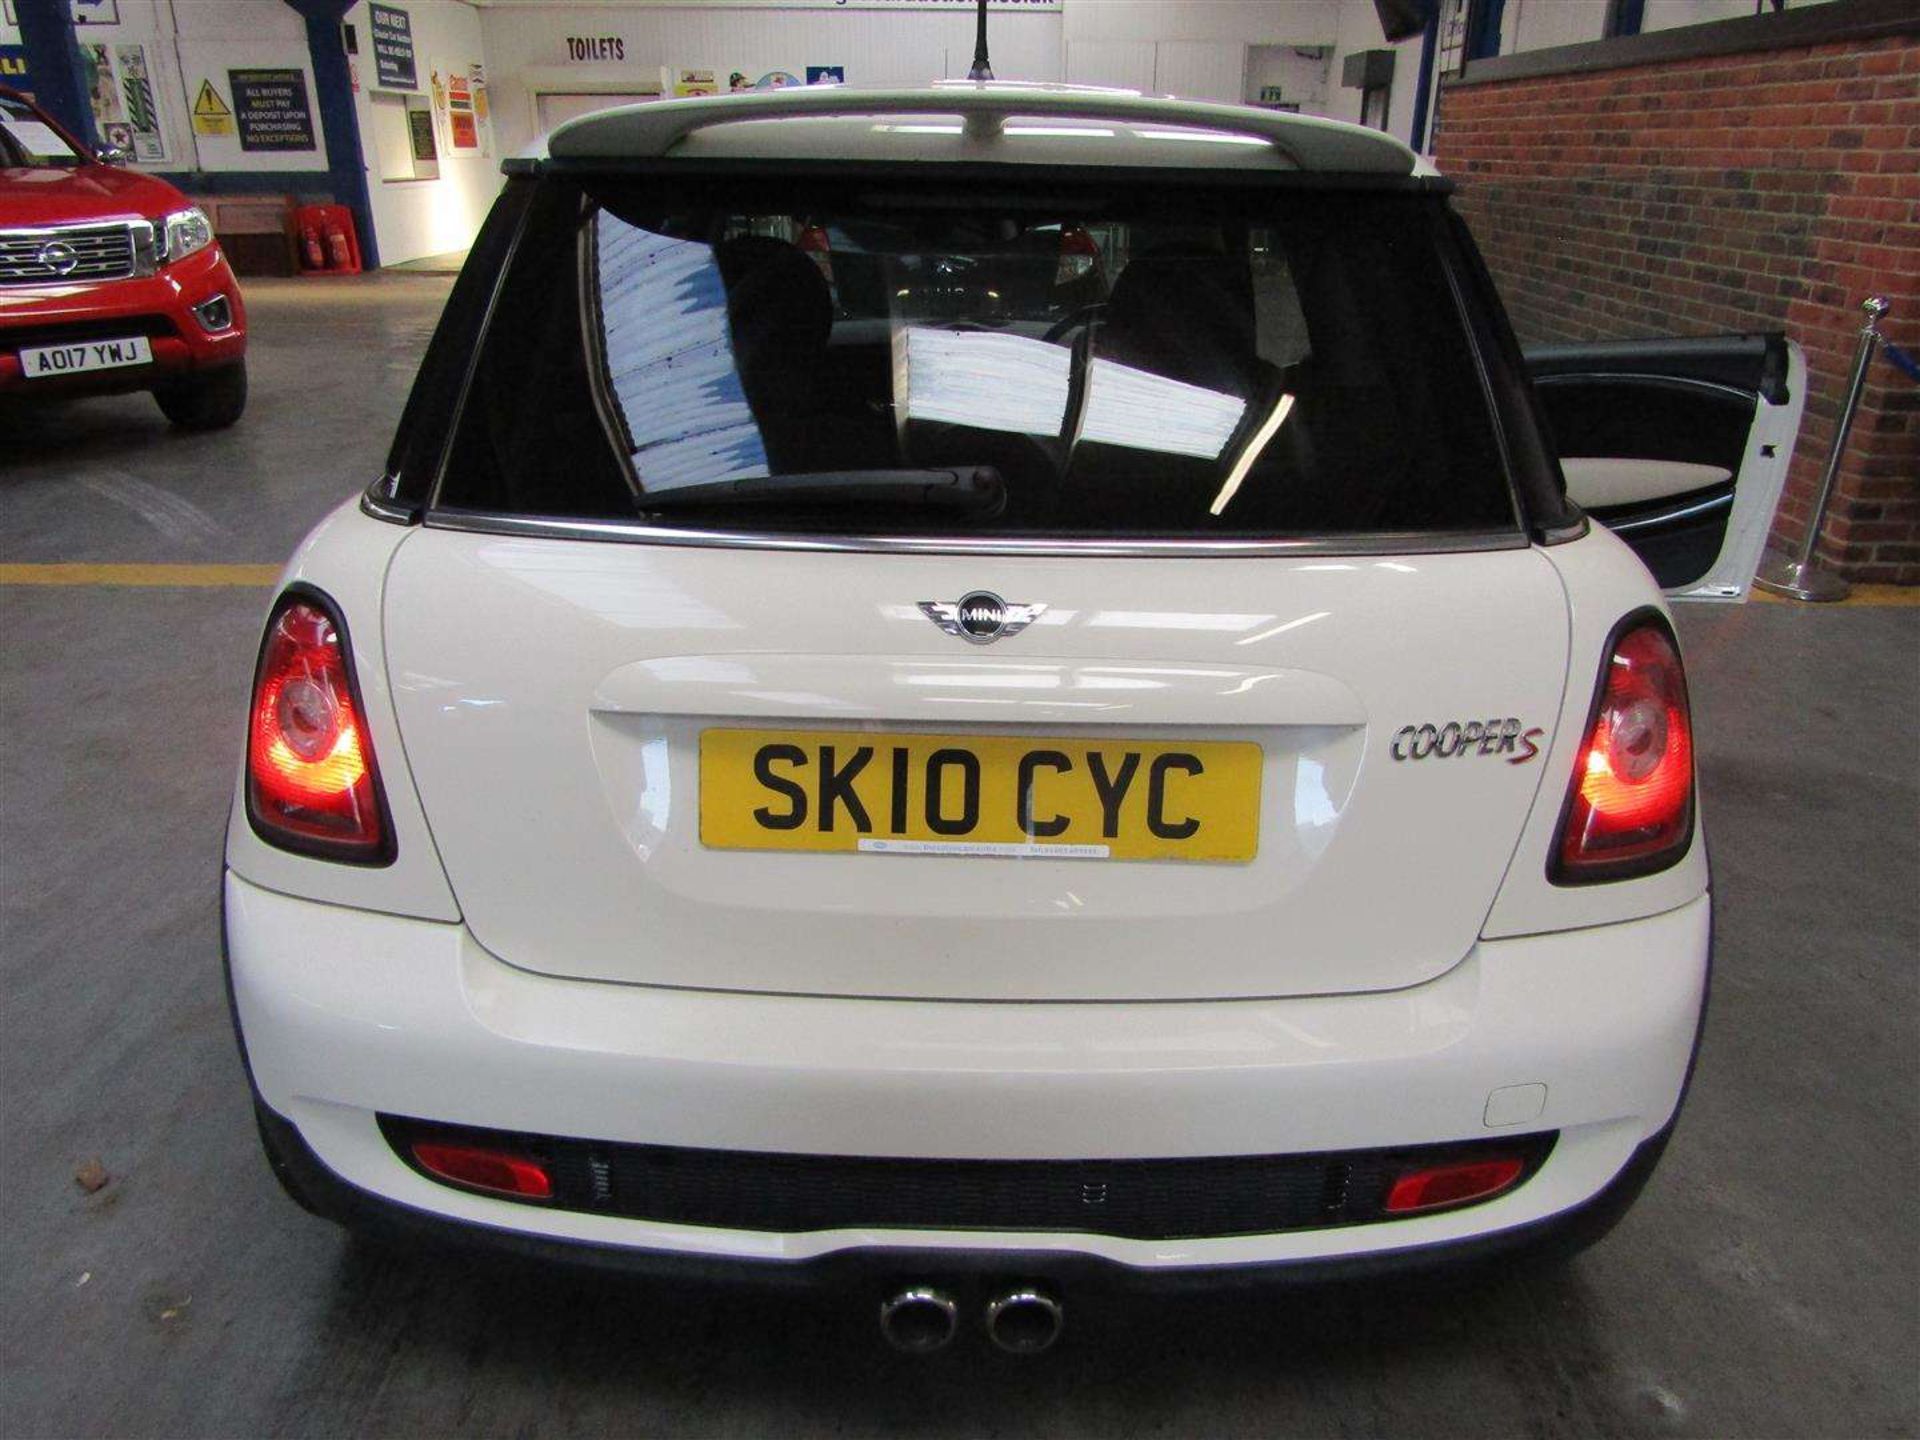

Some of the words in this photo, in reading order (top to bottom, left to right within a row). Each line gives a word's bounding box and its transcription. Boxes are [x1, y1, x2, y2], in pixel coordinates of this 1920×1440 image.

[566, 37, 625, 60] TOILETS
[246, 88, 260, 96] ALL
[261, 88, 292, 96] BUYERS
[250, 100, 275, 108] MUST
[276, 100, 290, 108] PAY
[247, 111, 281, 119] DEPOSIT
[283, 111, 306, 119] UPON
[250, 123, 302, 131] PURCHASING
[246, 134, 259, 142] NO
[260, 134, 309, 142] EXCEPTIONS
[39, 347, 86, 371] AO17
[93, 342, 138, 364] YWJ
[961, 607, 1003, 622] MINI
[1389, 717, 1522, 762] COOPER
[1506, 727, 1545, 765] S
[753, 743, 981, 835] SK10
[1017, 749, 1204, 840] CYC
